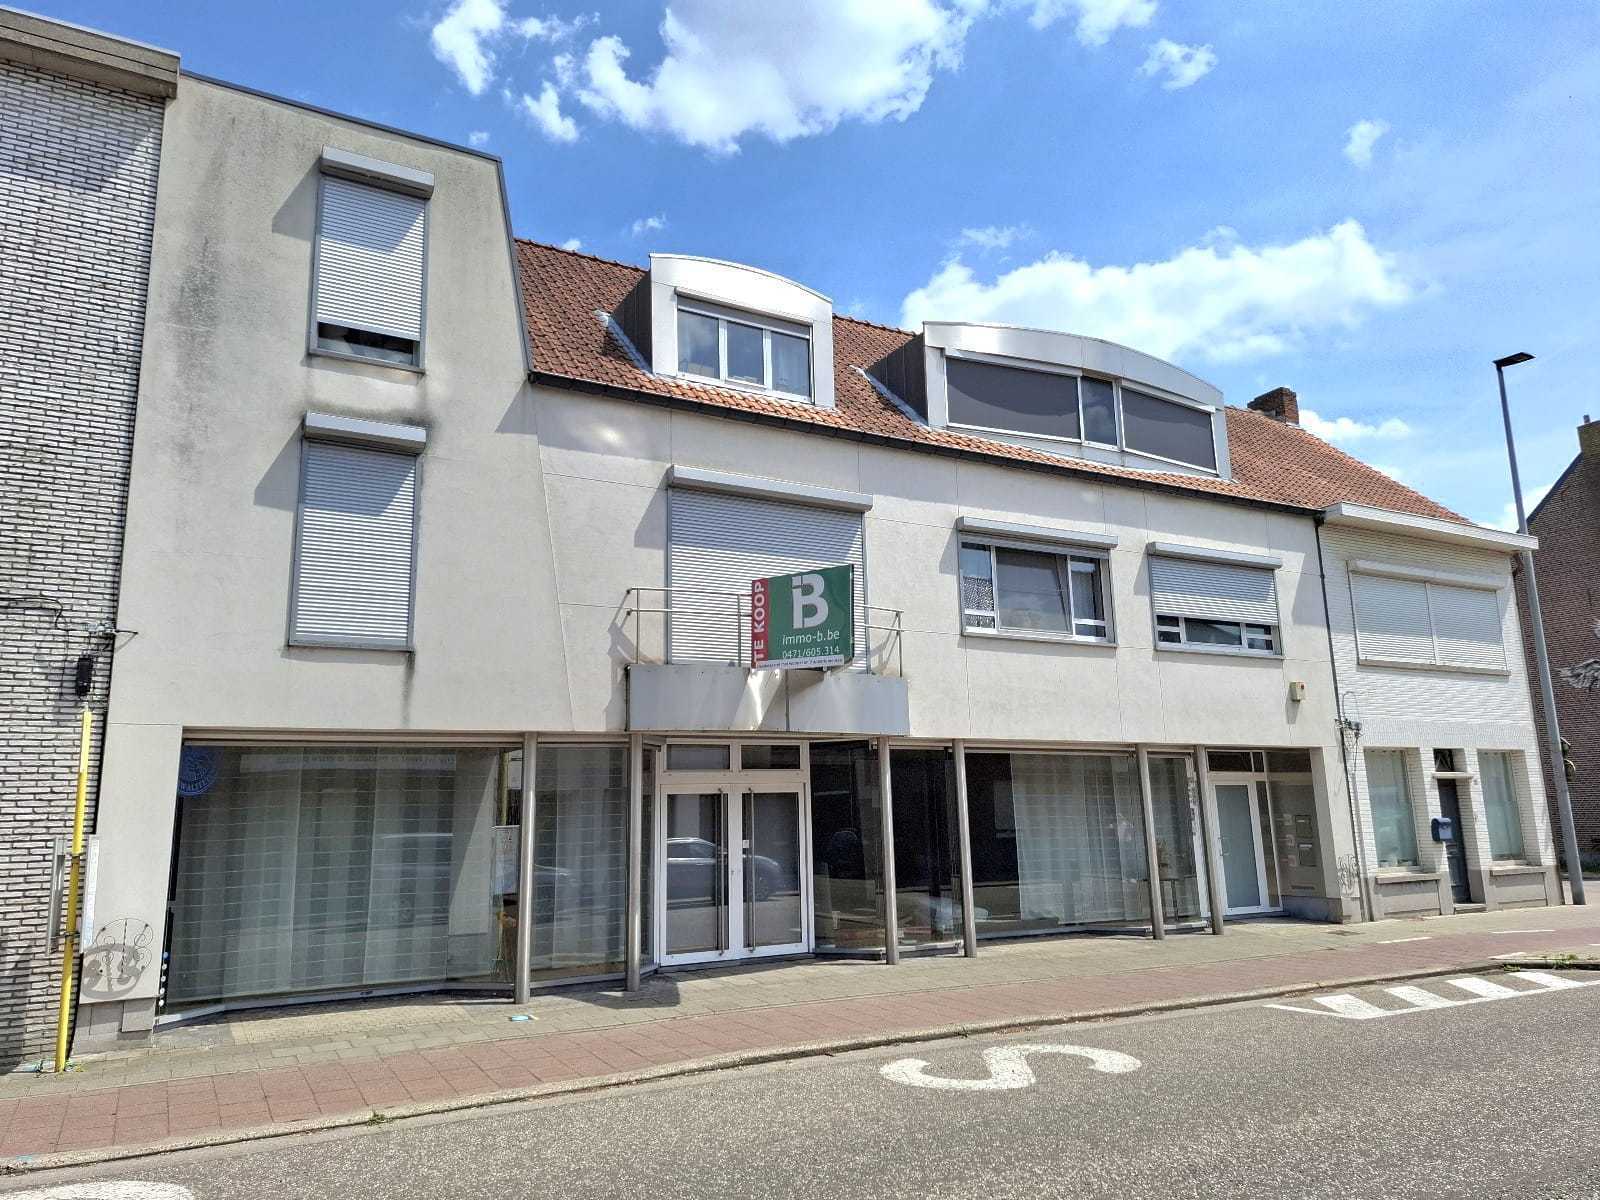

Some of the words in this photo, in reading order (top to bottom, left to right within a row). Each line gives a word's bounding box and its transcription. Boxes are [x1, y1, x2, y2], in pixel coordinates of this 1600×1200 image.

[753, 581, 765, 633] KOOP
[782, 629, 840, 645] immo-b.be
[753, 639, 765, 662] TE
